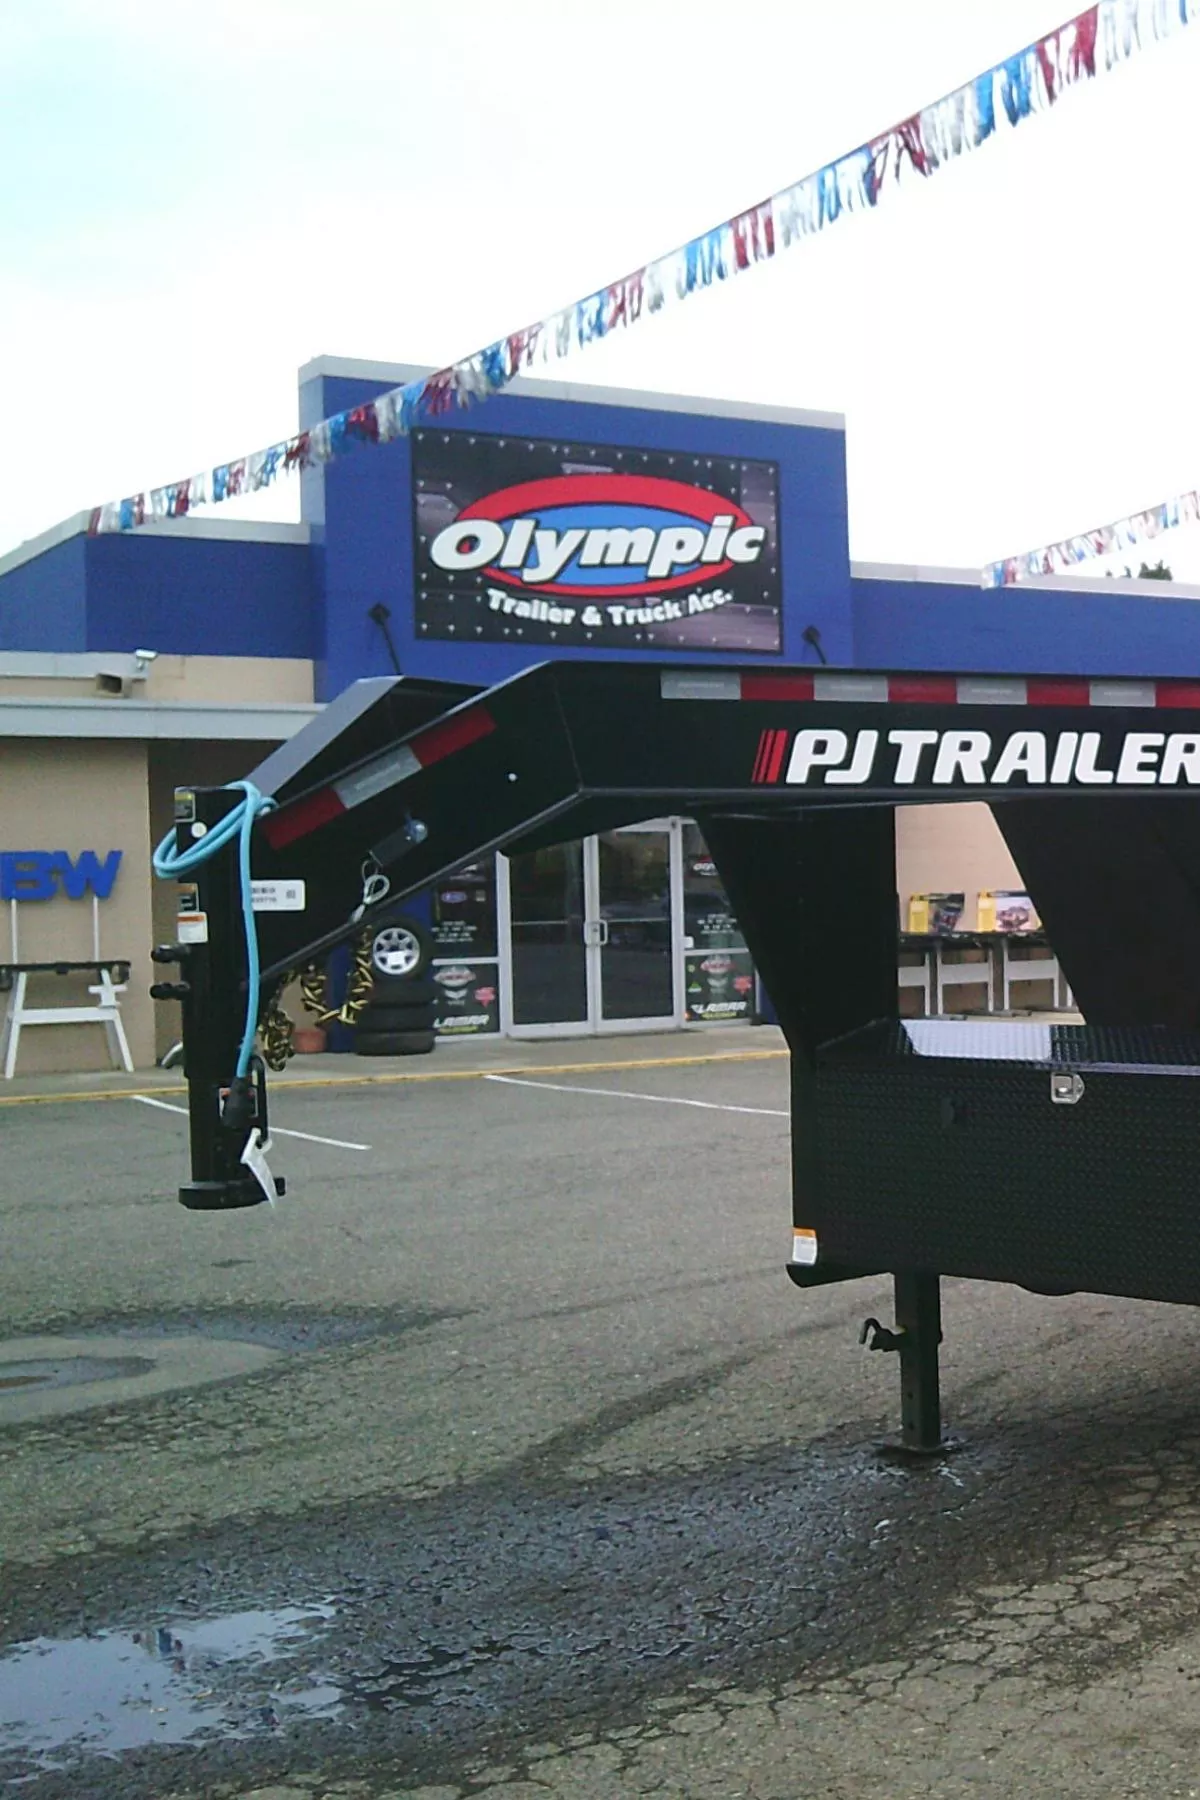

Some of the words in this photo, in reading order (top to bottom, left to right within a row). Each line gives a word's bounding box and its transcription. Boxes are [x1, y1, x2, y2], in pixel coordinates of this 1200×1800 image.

[430, 515, 766, 583] Olympic
[487, 588, 576, 624] Trailer
[581, 609, 603, 627] &
[611, 601, 681, 626] Truck
[687, 588, 733, 614] Acc.
[786, 729, 878, 783] PJ
